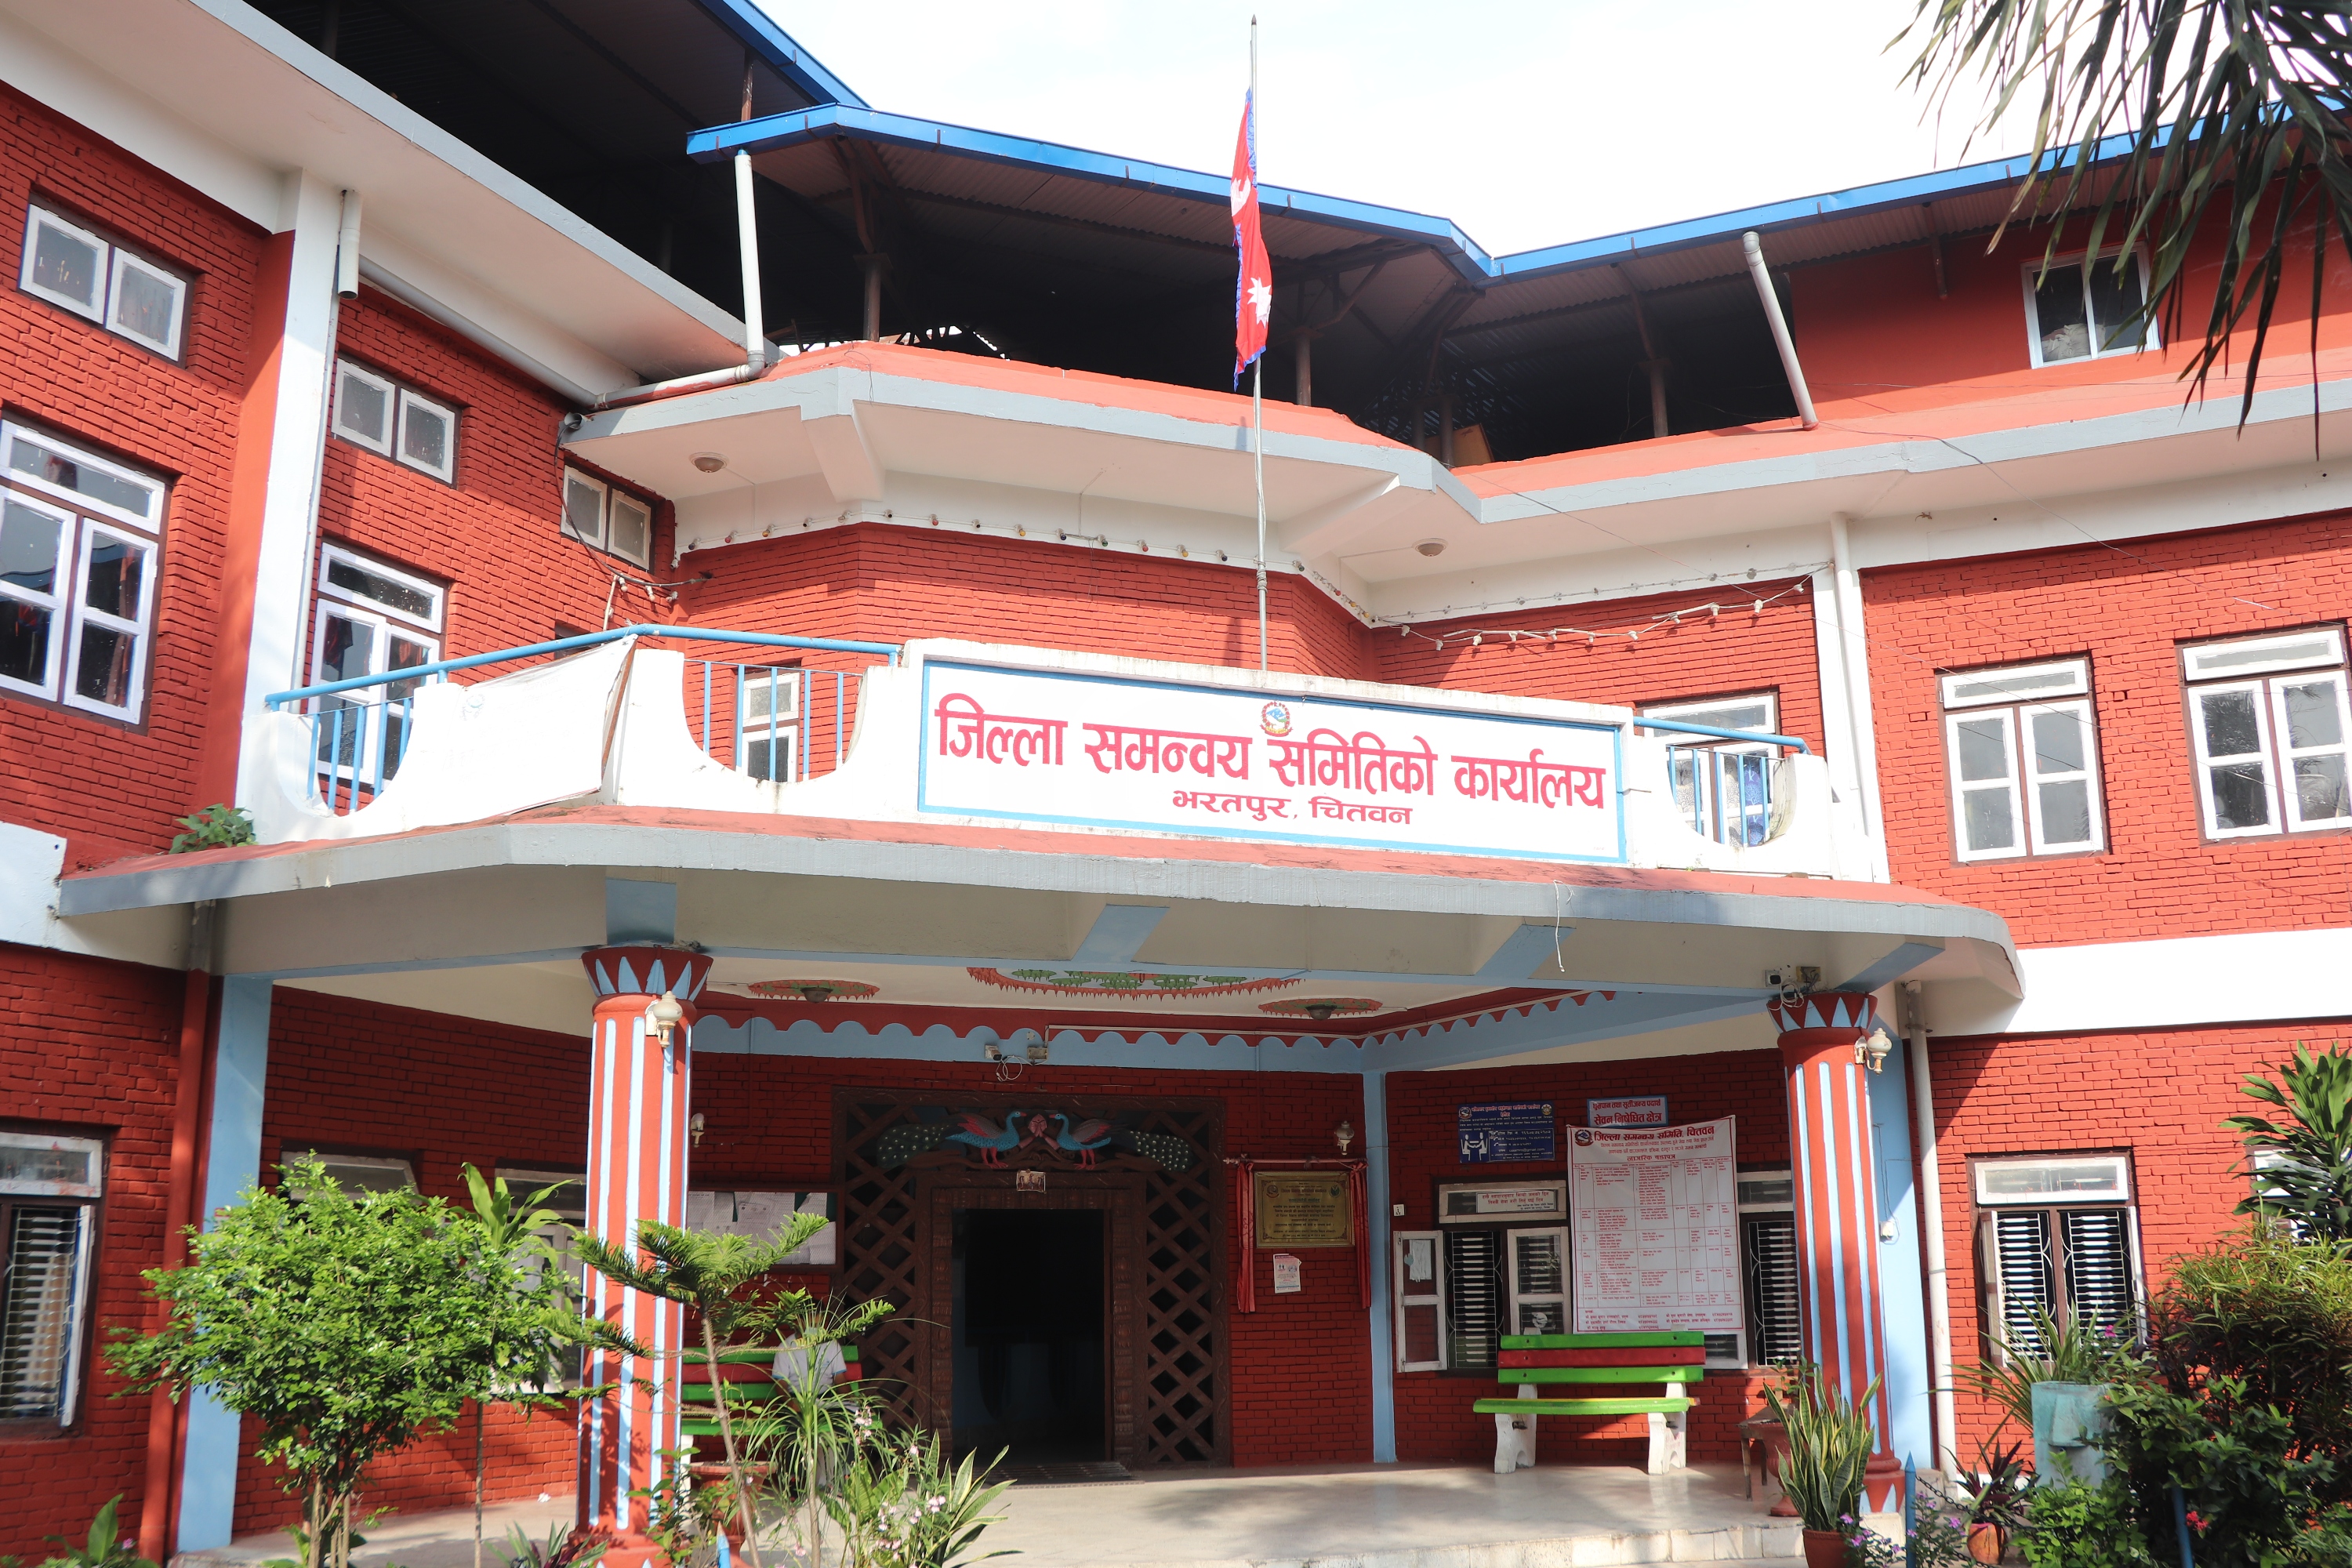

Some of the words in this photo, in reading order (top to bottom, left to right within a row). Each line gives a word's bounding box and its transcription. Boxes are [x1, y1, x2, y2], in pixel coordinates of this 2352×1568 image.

[935, 693, 1068, 767] जिल्ला
[1083, 723, 1253, 779] समन्वय
[1267, 728, 1438, 795] समितिको
[1451, 749, 1606, 809] कार्यालय
[1308, 796, 1413, 824] चितवन
[1594, 1114, 1613, 1126] सेवन
[1646, 1110, 1662, 1123] क्षेत्र
[1595, 1131, 1621, 1142] जिल्ला
[1687, 1126, 1715, 1137] चितवन
